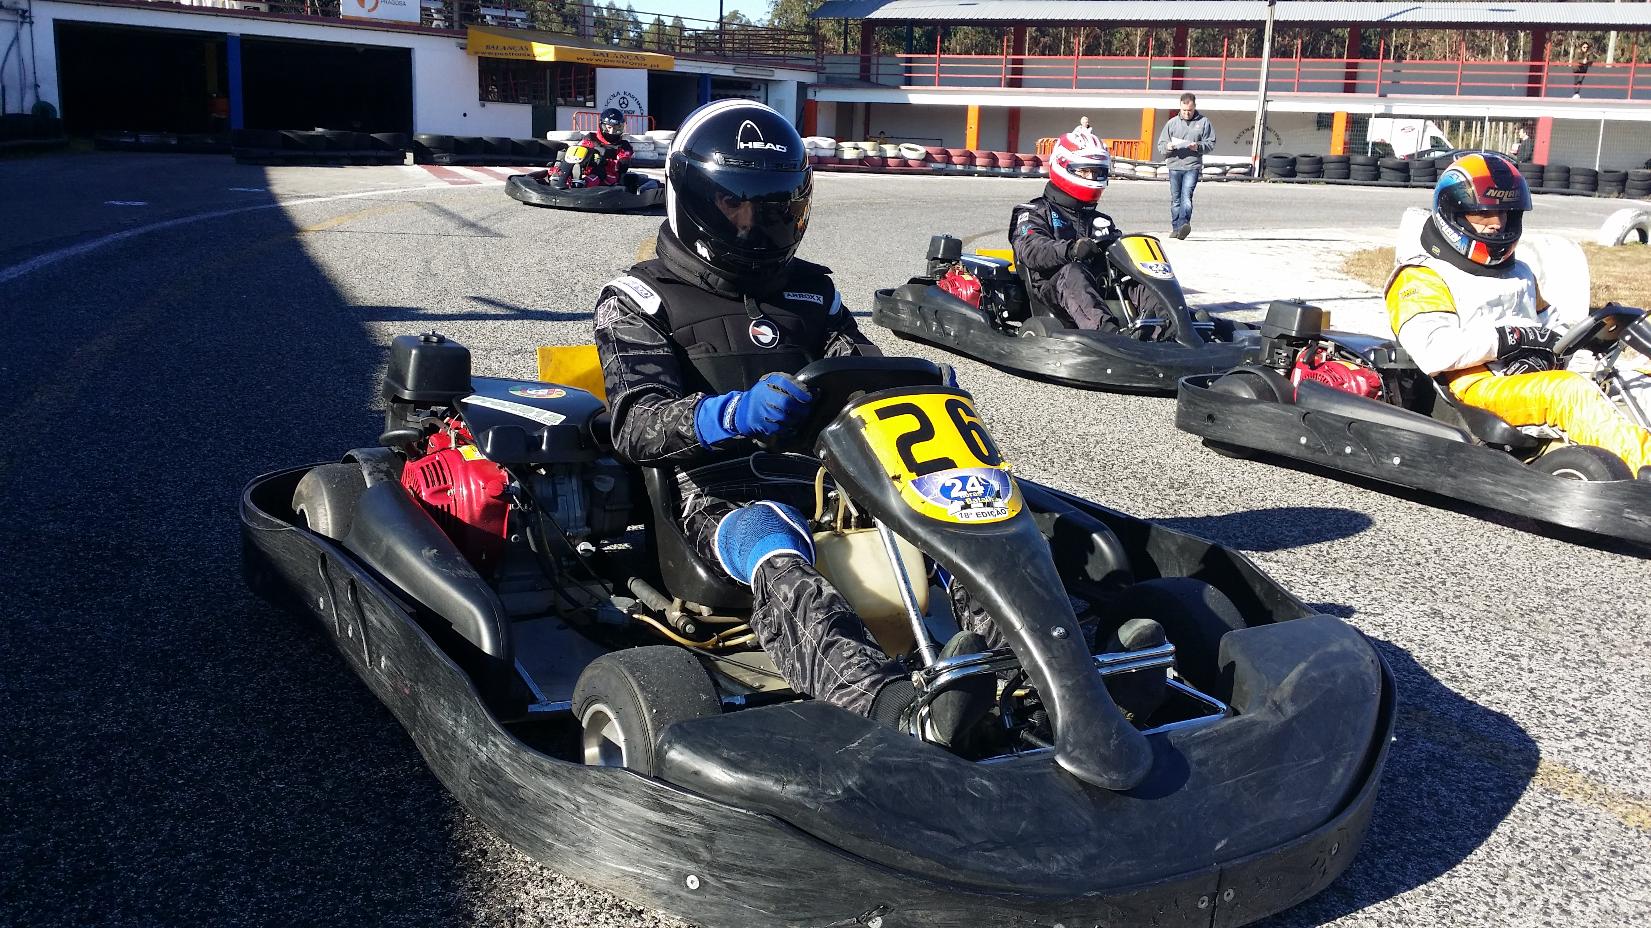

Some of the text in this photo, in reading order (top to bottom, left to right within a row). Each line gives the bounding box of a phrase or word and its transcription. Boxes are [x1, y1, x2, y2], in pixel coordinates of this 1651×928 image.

[739, 141, 787, 153] HEAD
[1143, 238, 1168, 263] 11
[873, 398, 1005, 477] 26
